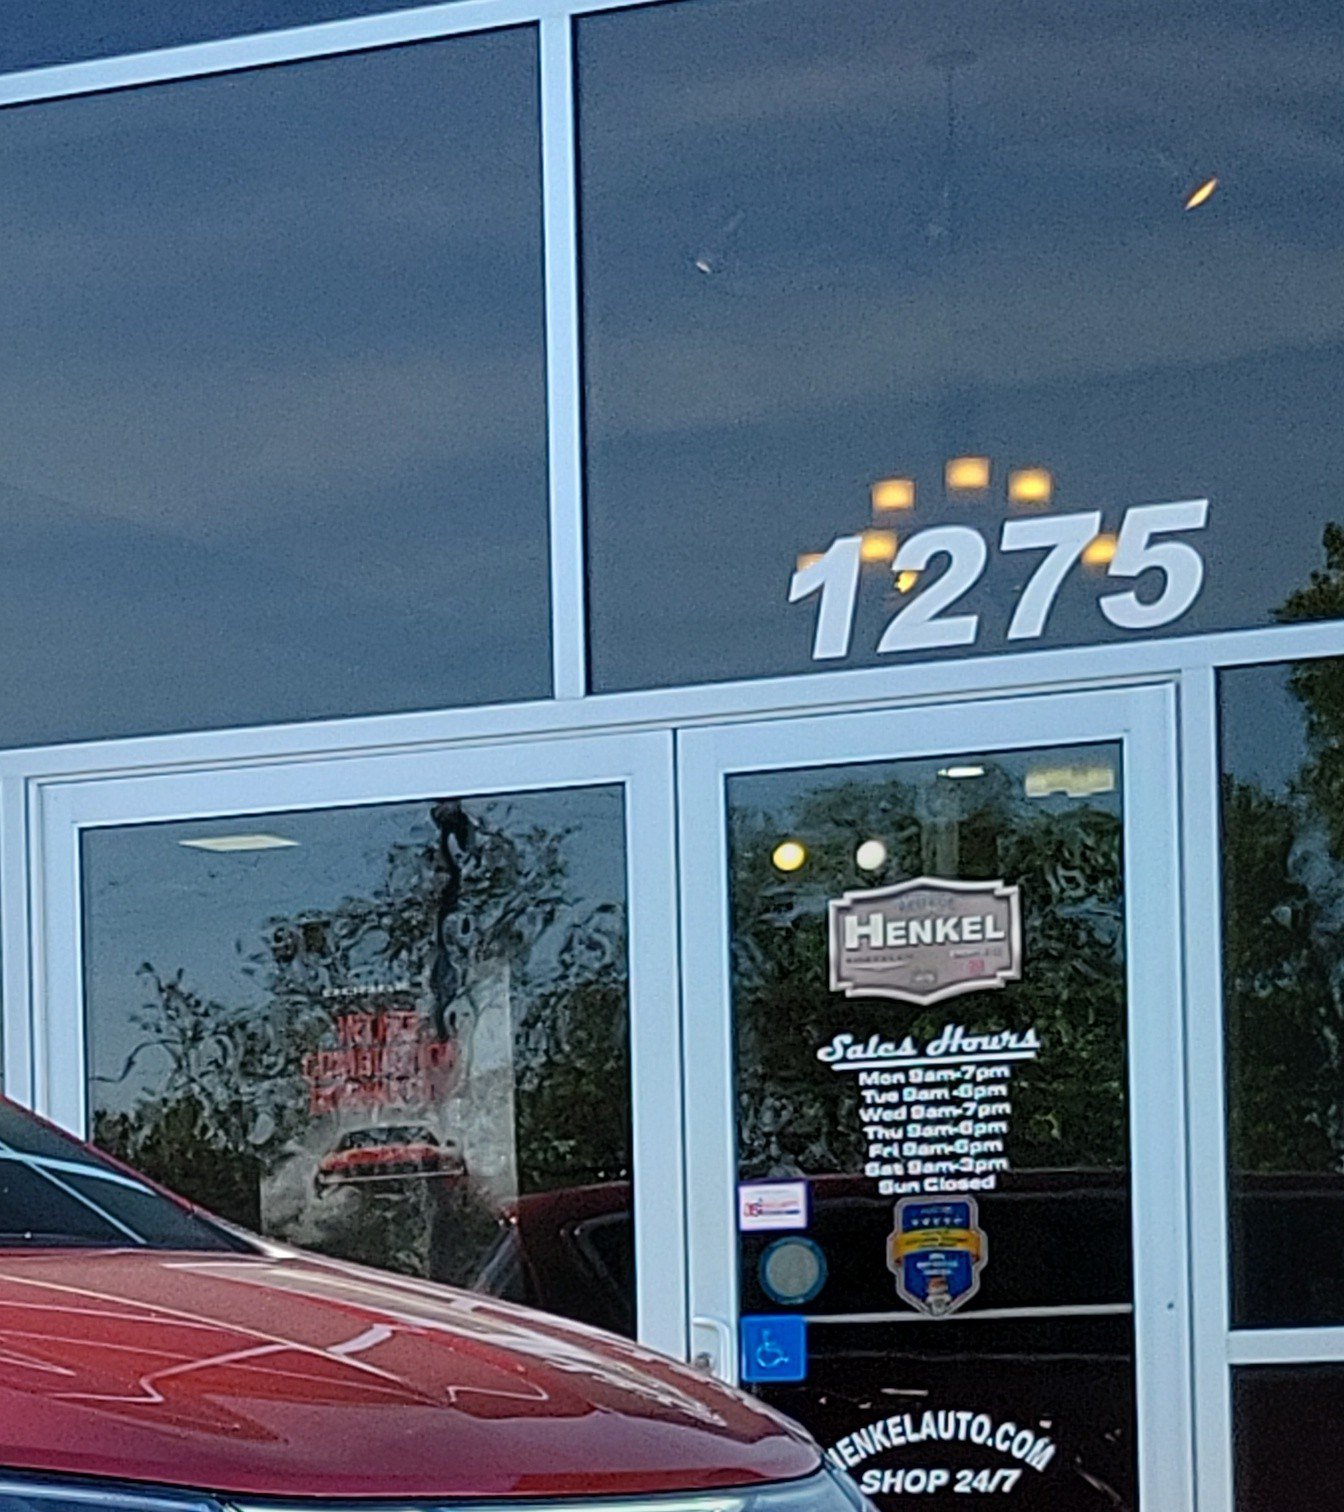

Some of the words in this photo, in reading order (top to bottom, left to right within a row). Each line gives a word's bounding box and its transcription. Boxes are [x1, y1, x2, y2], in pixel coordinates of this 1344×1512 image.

[788, 499, 1210, 661] 1275
[844, 912, 1005, 950] HENKEL
[816, 1033, 918, 1062] Sales
[925, 1023, 1041, 1057] Hours
[858, 1071, 906, 1086] Mon
[861, 1089, 900, 1104] Tue
[858, 1106, 908, 1122] Wed
[862, 1124, 904, 1140] Thu
[868, 1142, 900, 1158] Fri
[864, 1160, 904, 1177] Sat
[878, 1178, 921, 1195] Sun
[923, 1174, 996, 1192] Closed
[860, 1468, 951, 1494] SHOP
[953, 1467, 1023, 1493] 24/7
